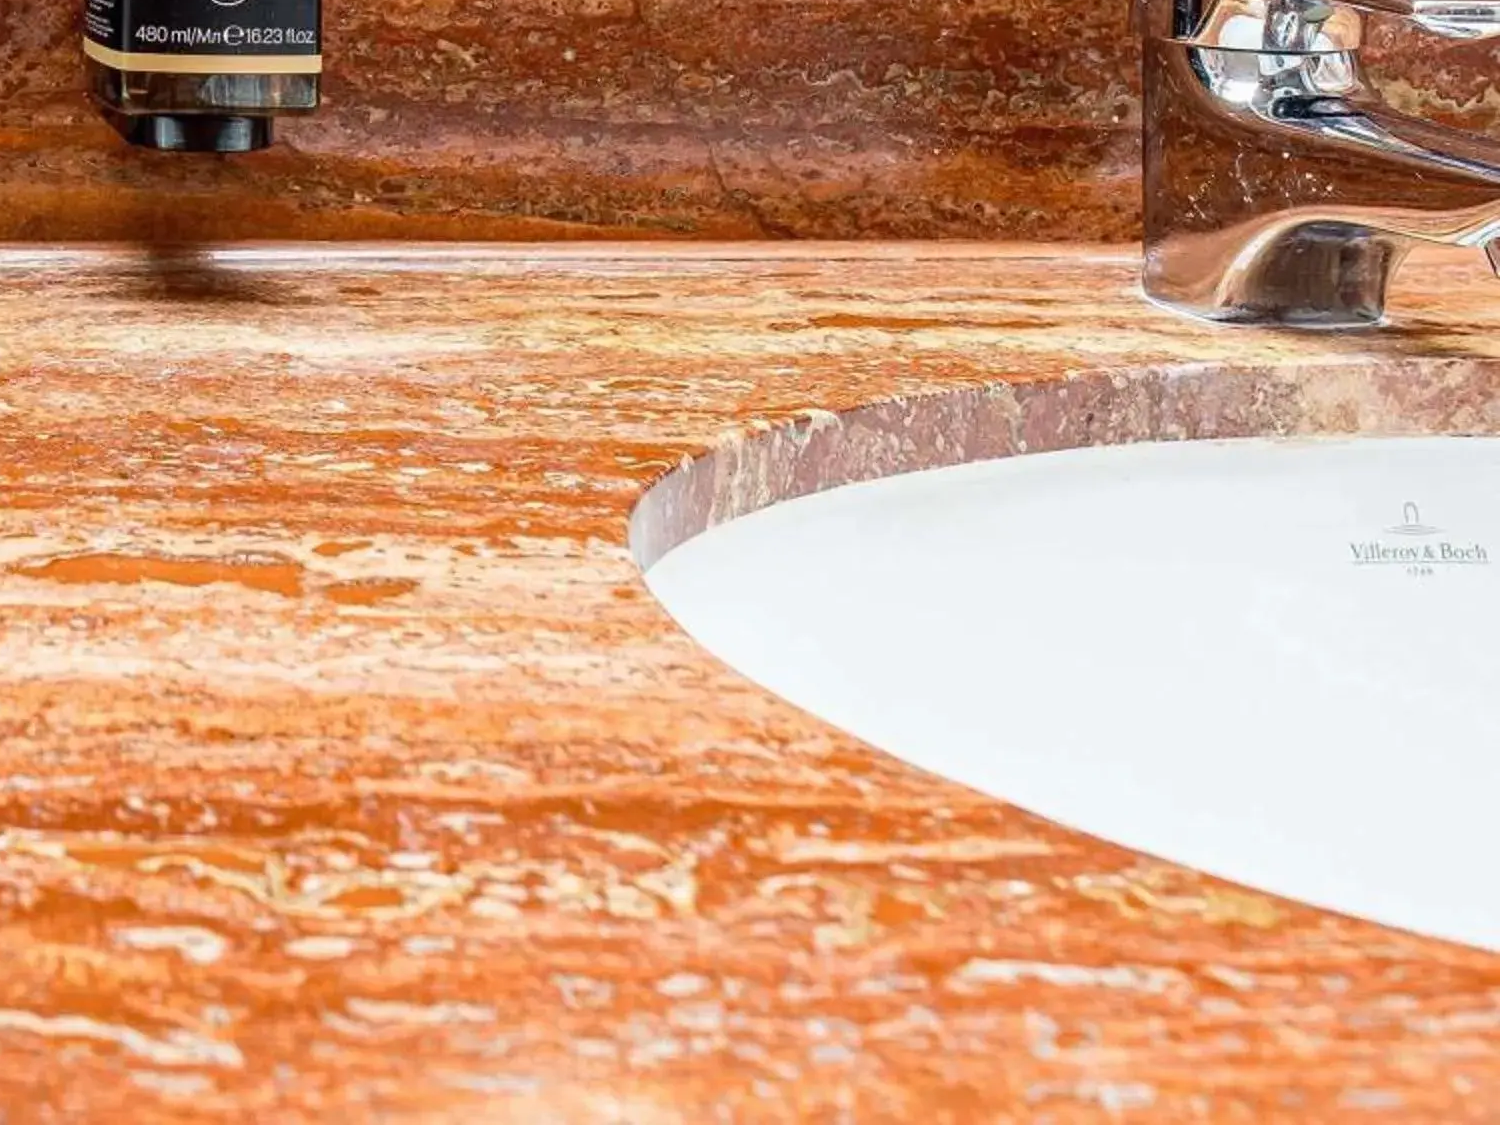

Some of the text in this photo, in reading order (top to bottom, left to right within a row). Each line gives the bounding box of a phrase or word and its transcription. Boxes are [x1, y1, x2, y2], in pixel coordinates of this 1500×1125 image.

[135, 25, 169, 43] 480
[1350, 542, 1488, 560] Villeroy & Boch
